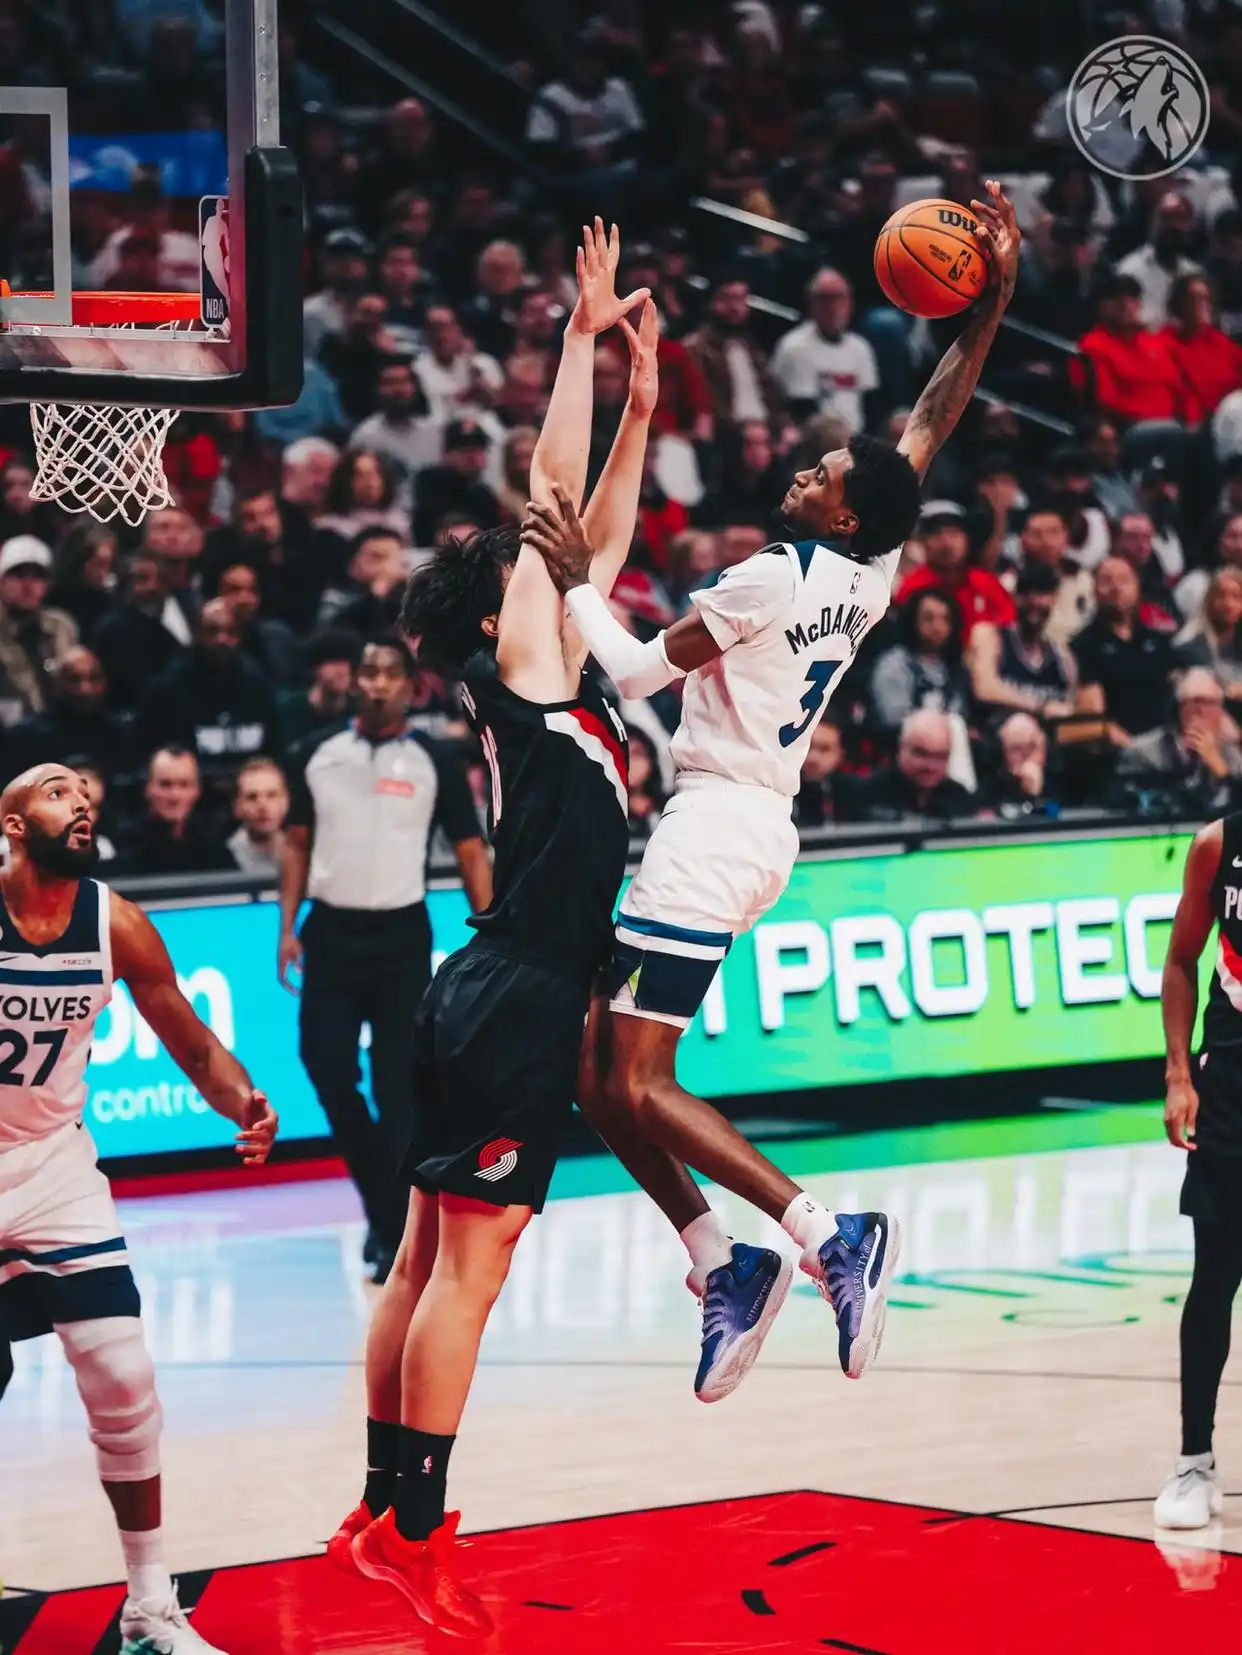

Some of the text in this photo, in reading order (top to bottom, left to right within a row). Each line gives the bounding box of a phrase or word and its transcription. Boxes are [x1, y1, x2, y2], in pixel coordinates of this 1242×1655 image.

[206, 298, 225, 319] NBA
[778, 660, 844, 748] 3
[0, 995, 92, 1022] OLVES
[0, 1028, 69, 1087] 27
